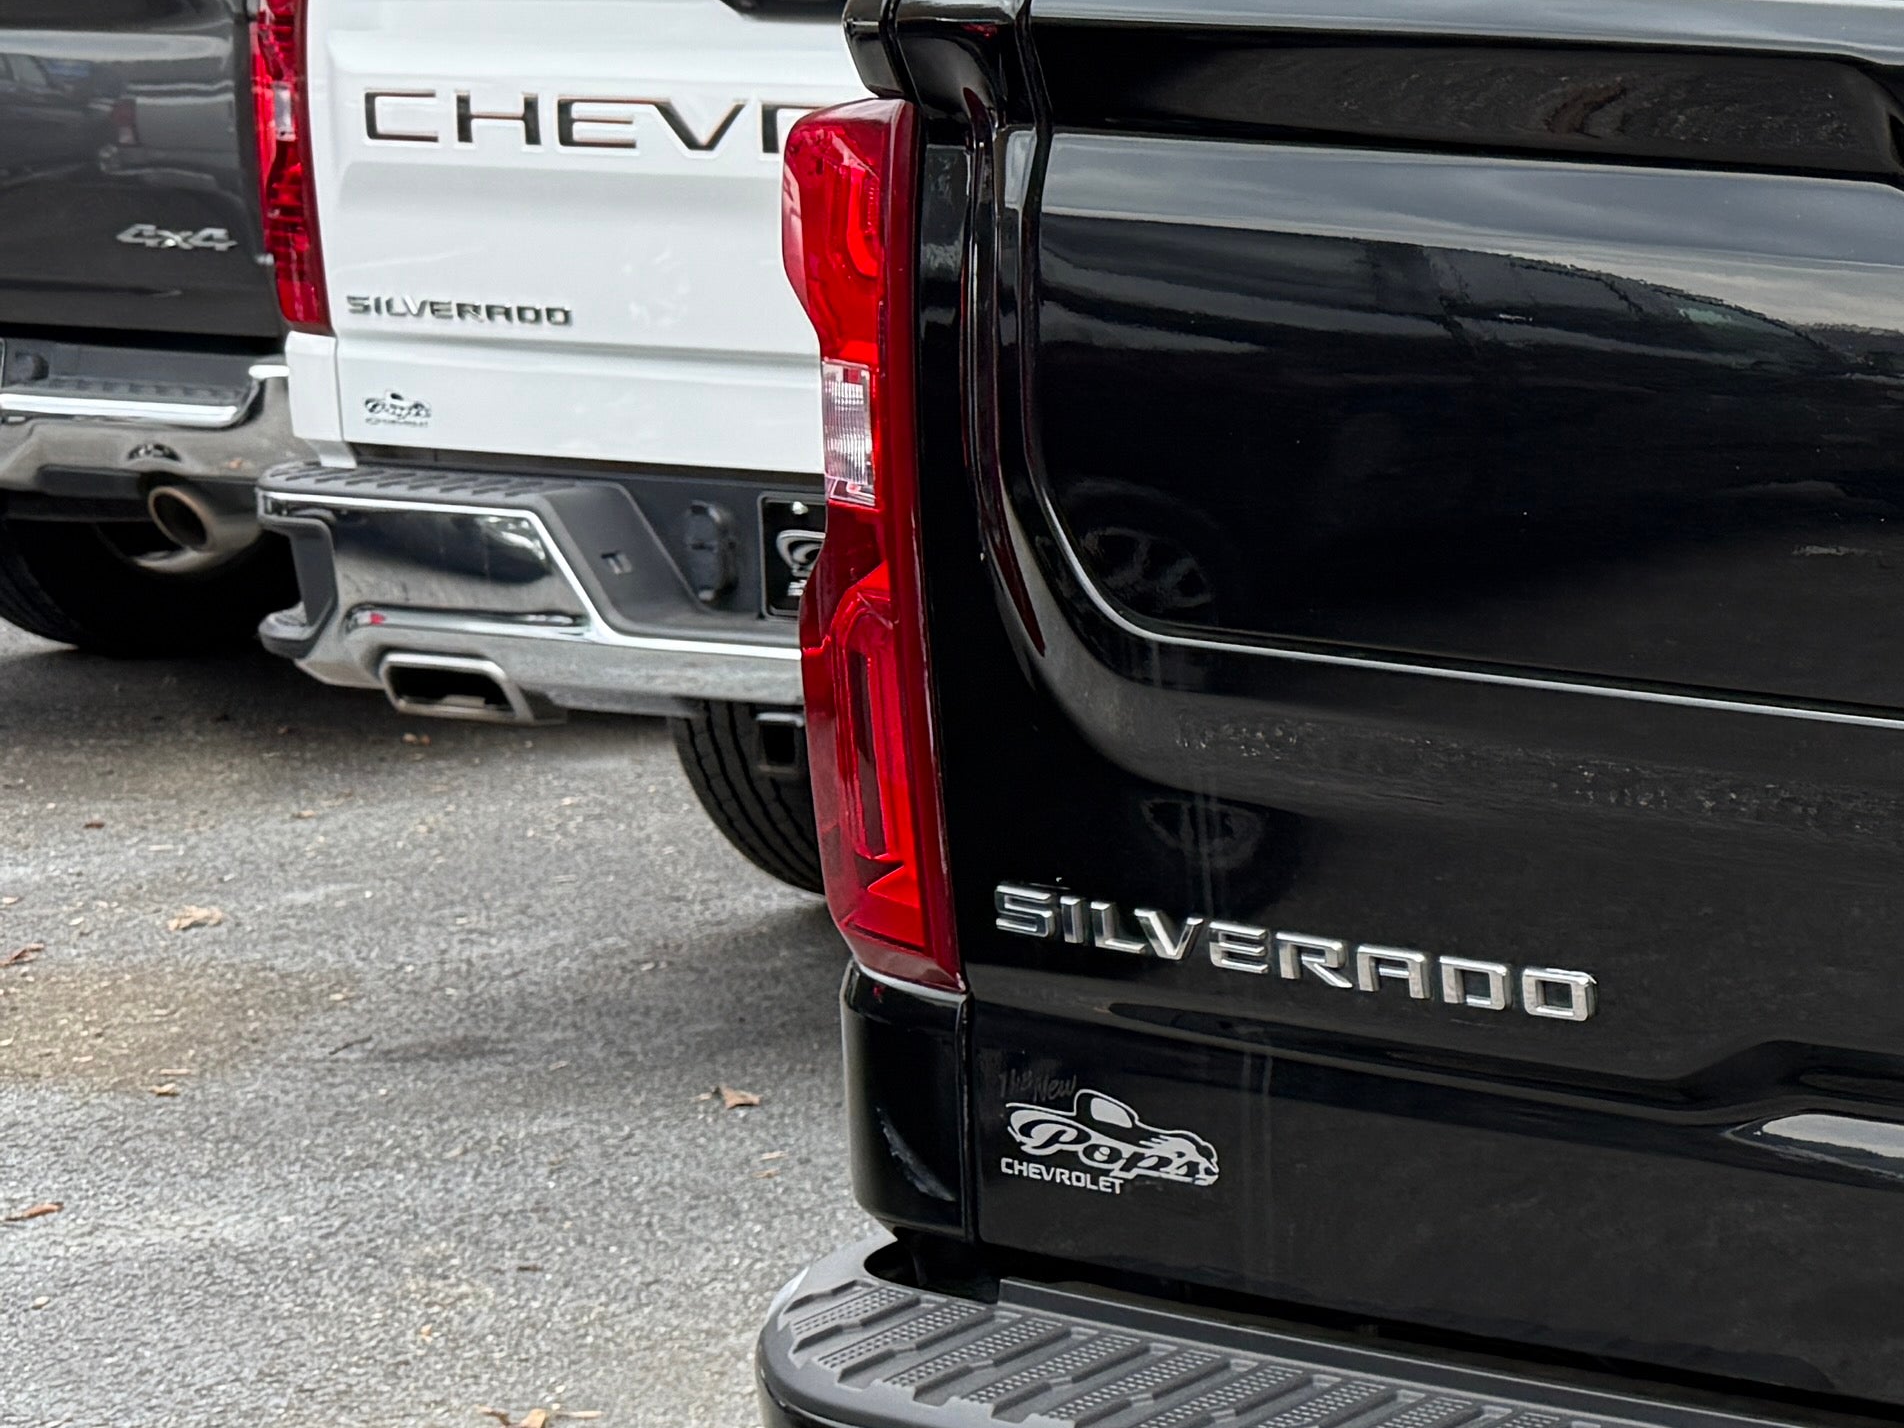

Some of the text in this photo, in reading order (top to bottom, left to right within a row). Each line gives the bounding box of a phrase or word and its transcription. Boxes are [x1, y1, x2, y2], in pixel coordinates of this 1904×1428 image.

[346, 294, 574, 326] SILVERADO
[995, 880, 1598, 1023] SILVERADO
[1000, 1156, 1125, 1195] CHEVROLET
